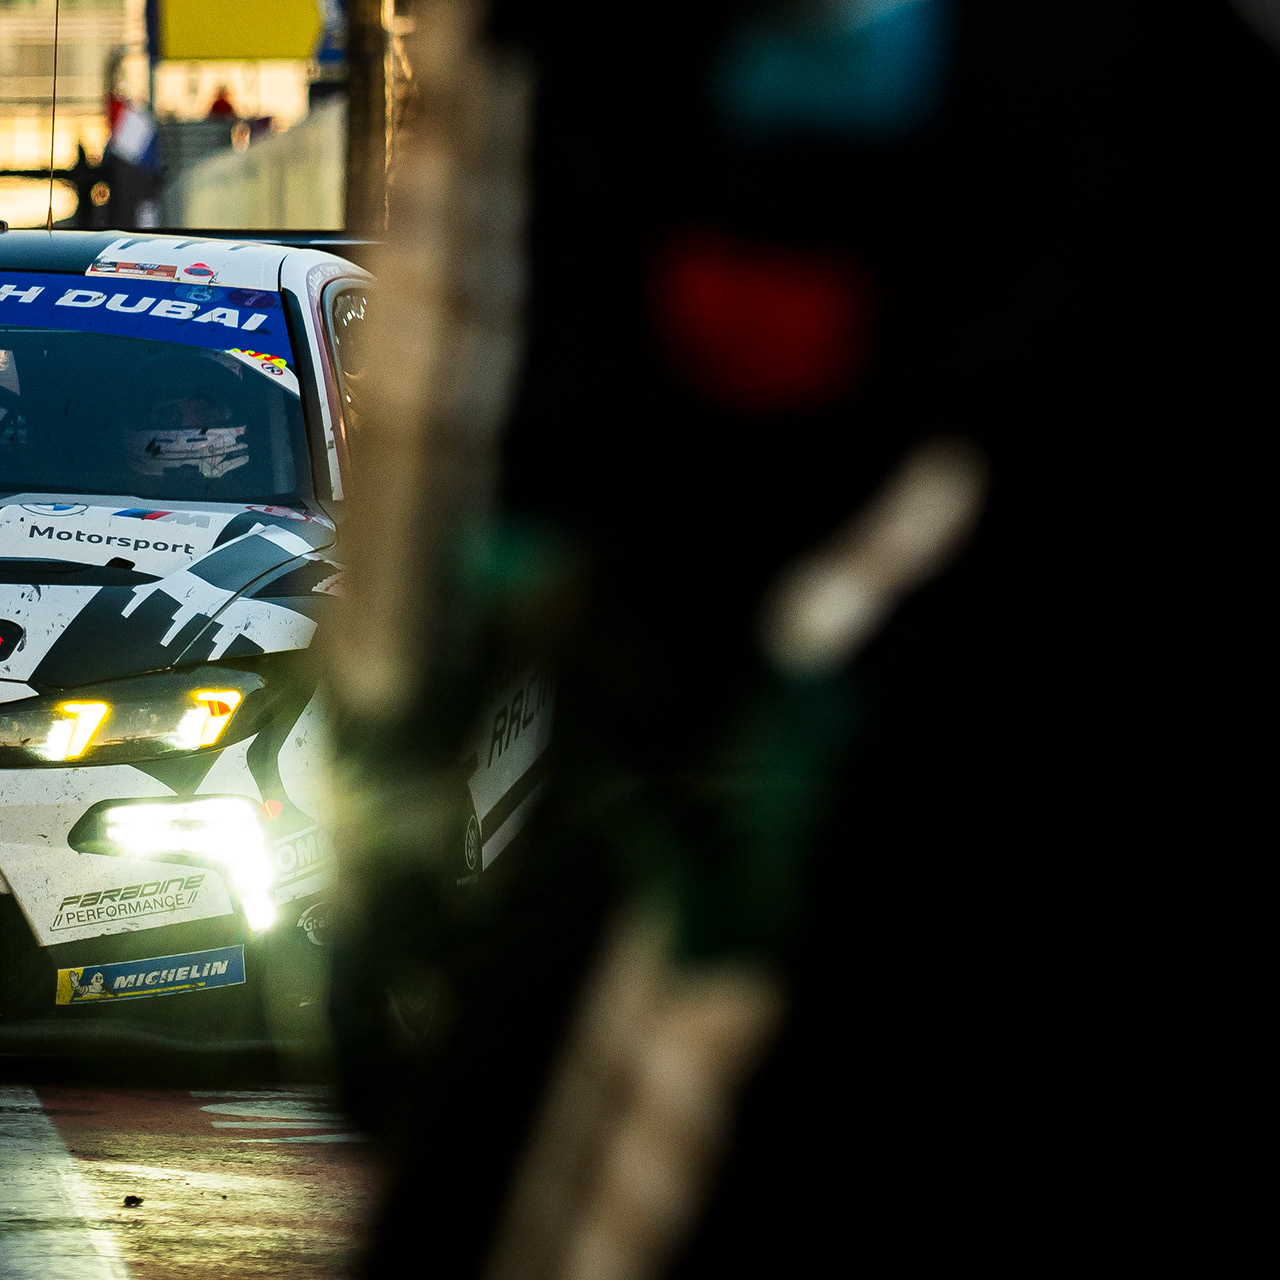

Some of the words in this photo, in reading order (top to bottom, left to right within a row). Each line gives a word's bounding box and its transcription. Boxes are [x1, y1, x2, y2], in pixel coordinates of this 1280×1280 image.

[55, 288, 269, 332] DUBAI
[28, 524, 195, 556] Motorsport
[113, 959, 229, 990] MICHELIN
